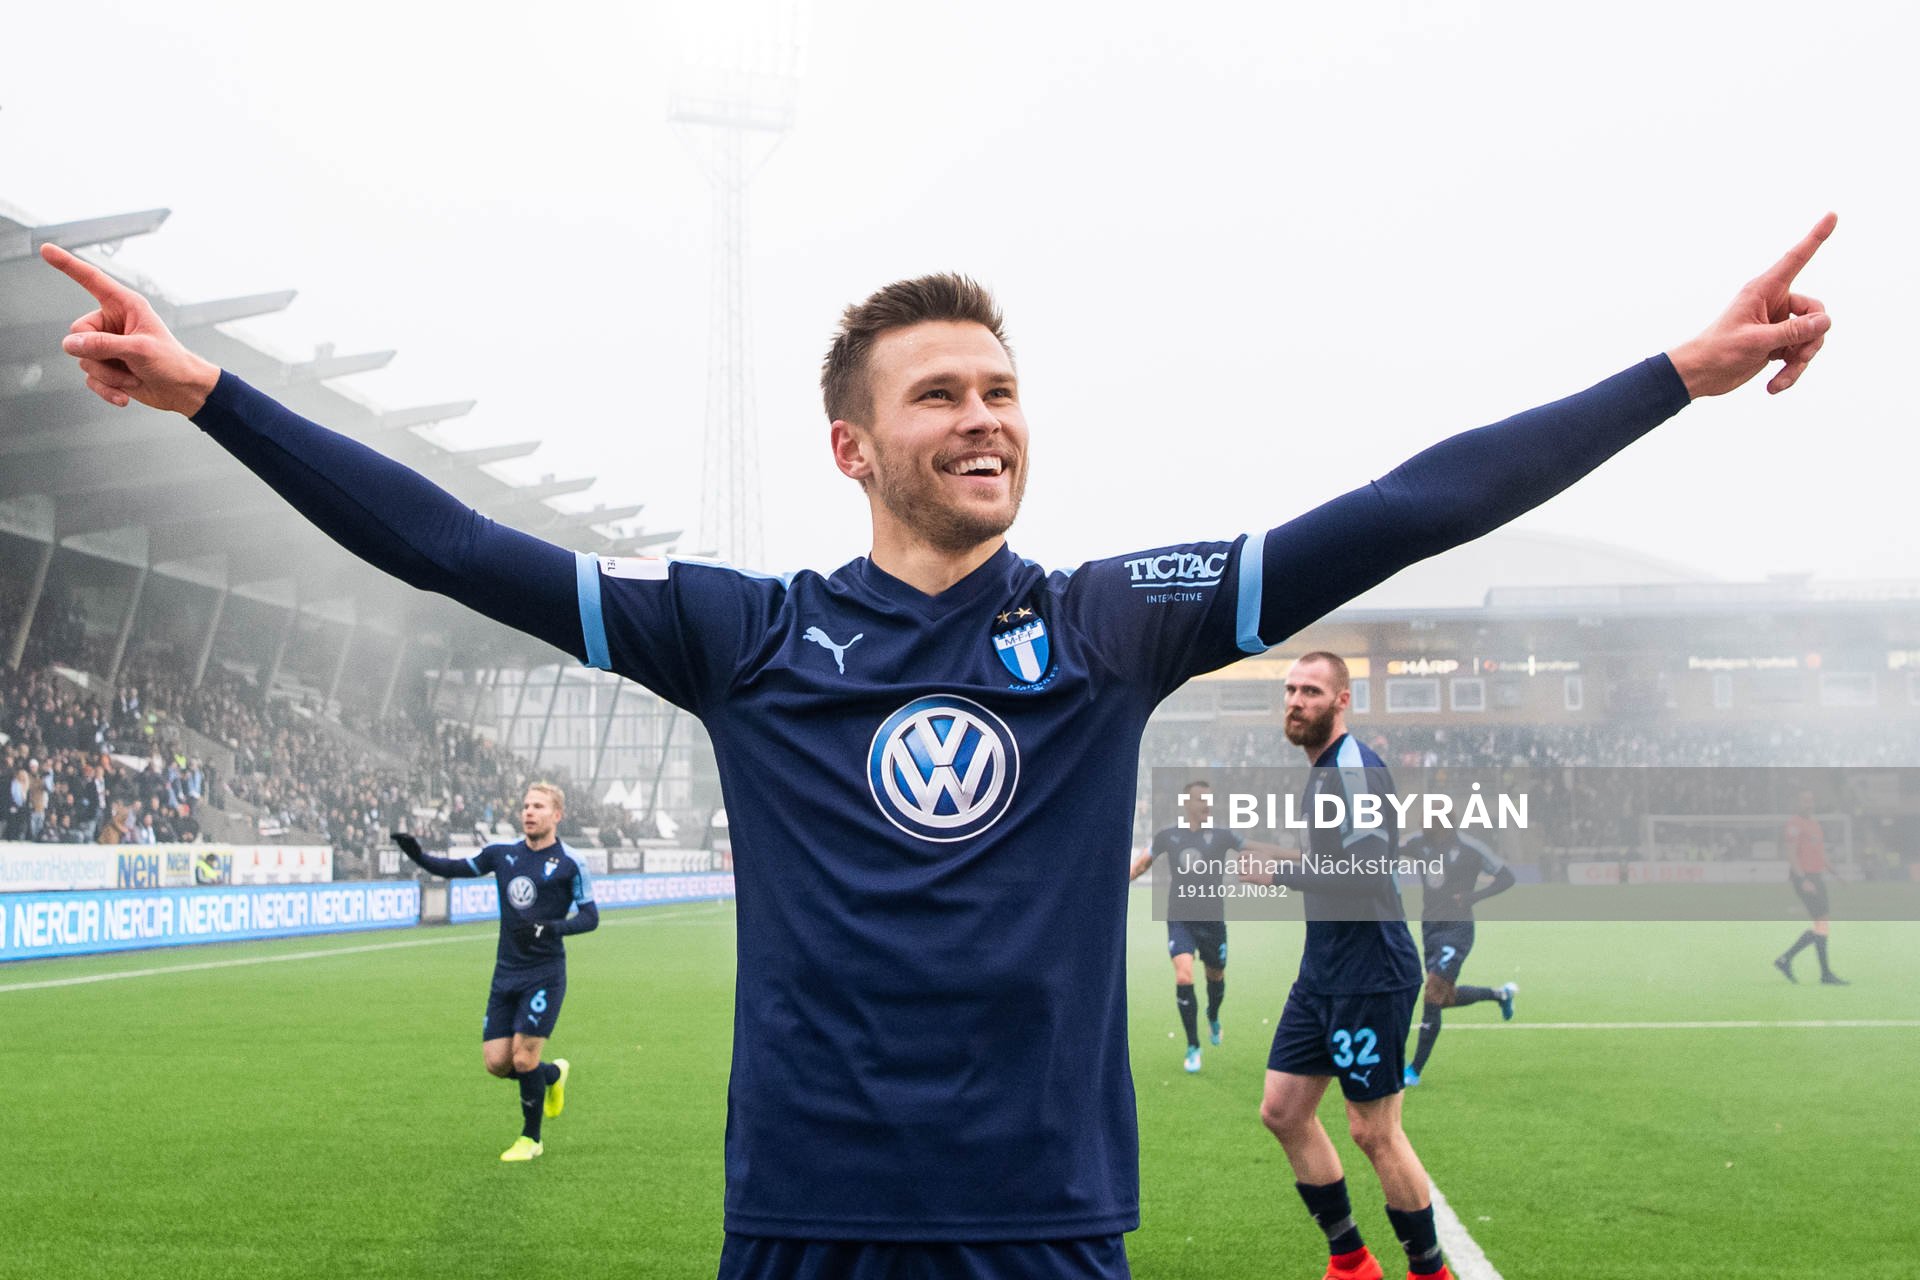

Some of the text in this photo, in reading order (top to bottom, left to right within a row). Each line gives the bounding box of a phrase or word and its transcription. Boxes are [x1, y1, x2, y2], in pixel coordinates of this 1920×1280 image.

[1124, 552, 1228, 580] TICTAC
[1146, 592, 1202, 604] INTEACTIVE
[14, 901, 99, 948] NERCIA
[104, 898, 173, 941] NERCIA
[180, 896, 249, 935] NERCIA
[252, 891, 308, 930] NERCIA
[312, 889, 365, 925] NERCIA
[530, 989, 547, 1013] 6
[1332, 1027, 1381, 1068] 32
